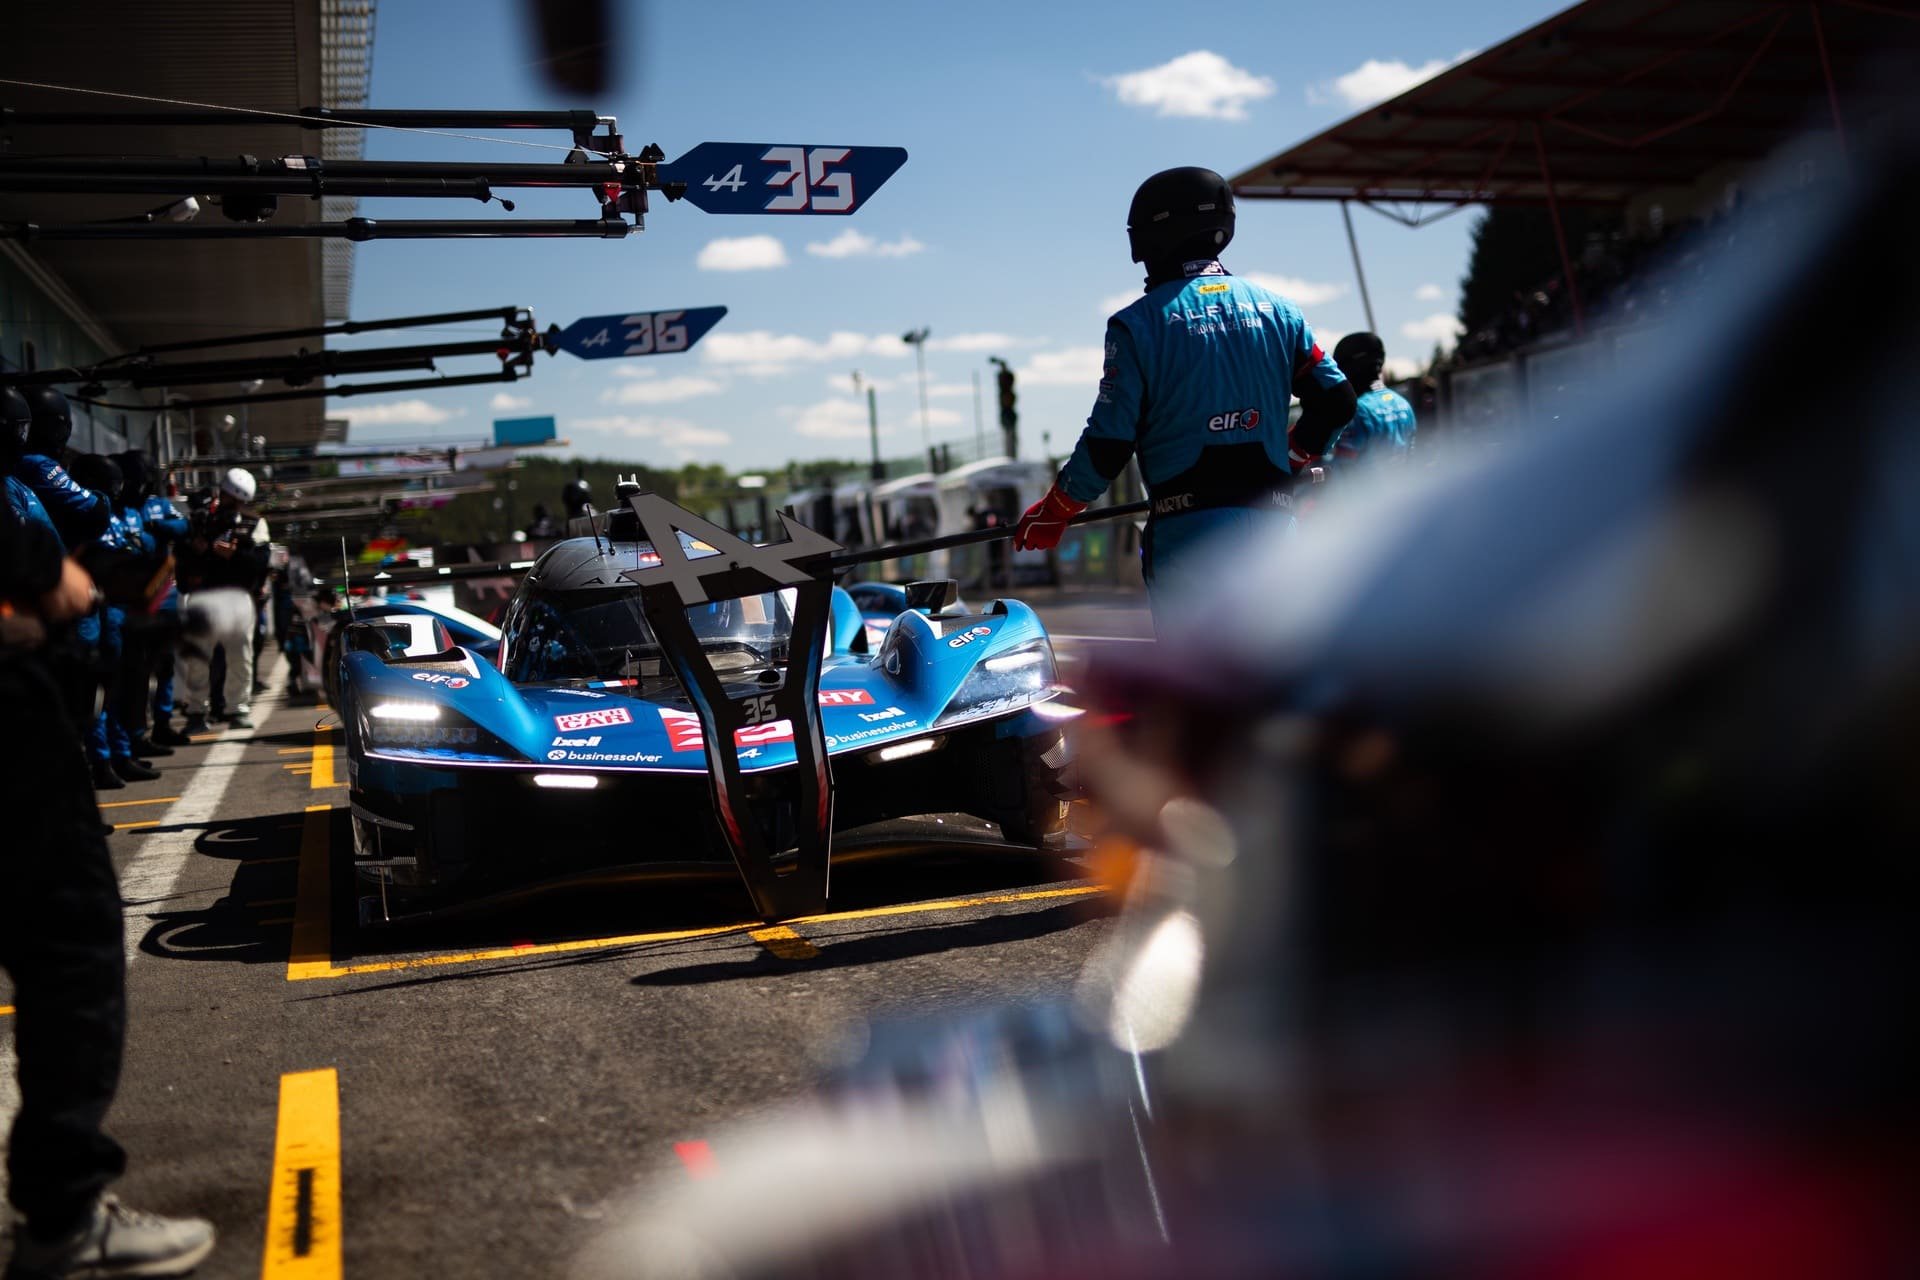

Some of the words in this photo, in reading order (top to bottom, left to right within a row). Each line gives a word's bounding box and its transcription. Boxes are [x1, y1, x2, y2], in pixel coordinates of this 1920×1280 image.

[760, 146, 854, 212] 35
[1168, 302, 1274, 325] ALPINE
[621, 311, 688, 356] 36
[1208, 412, 1241, 431] elf
[948, 631, 976, 648] elf
[412, 672, 452, 683] elf
[560, 708, 623, 722] HYPER
[742, 694, 778, 725] 35
[563, 713, 626, 729] CAR
[837, 719, 918, 743] businessolver
[567, 750, 663, 763] businessolver
